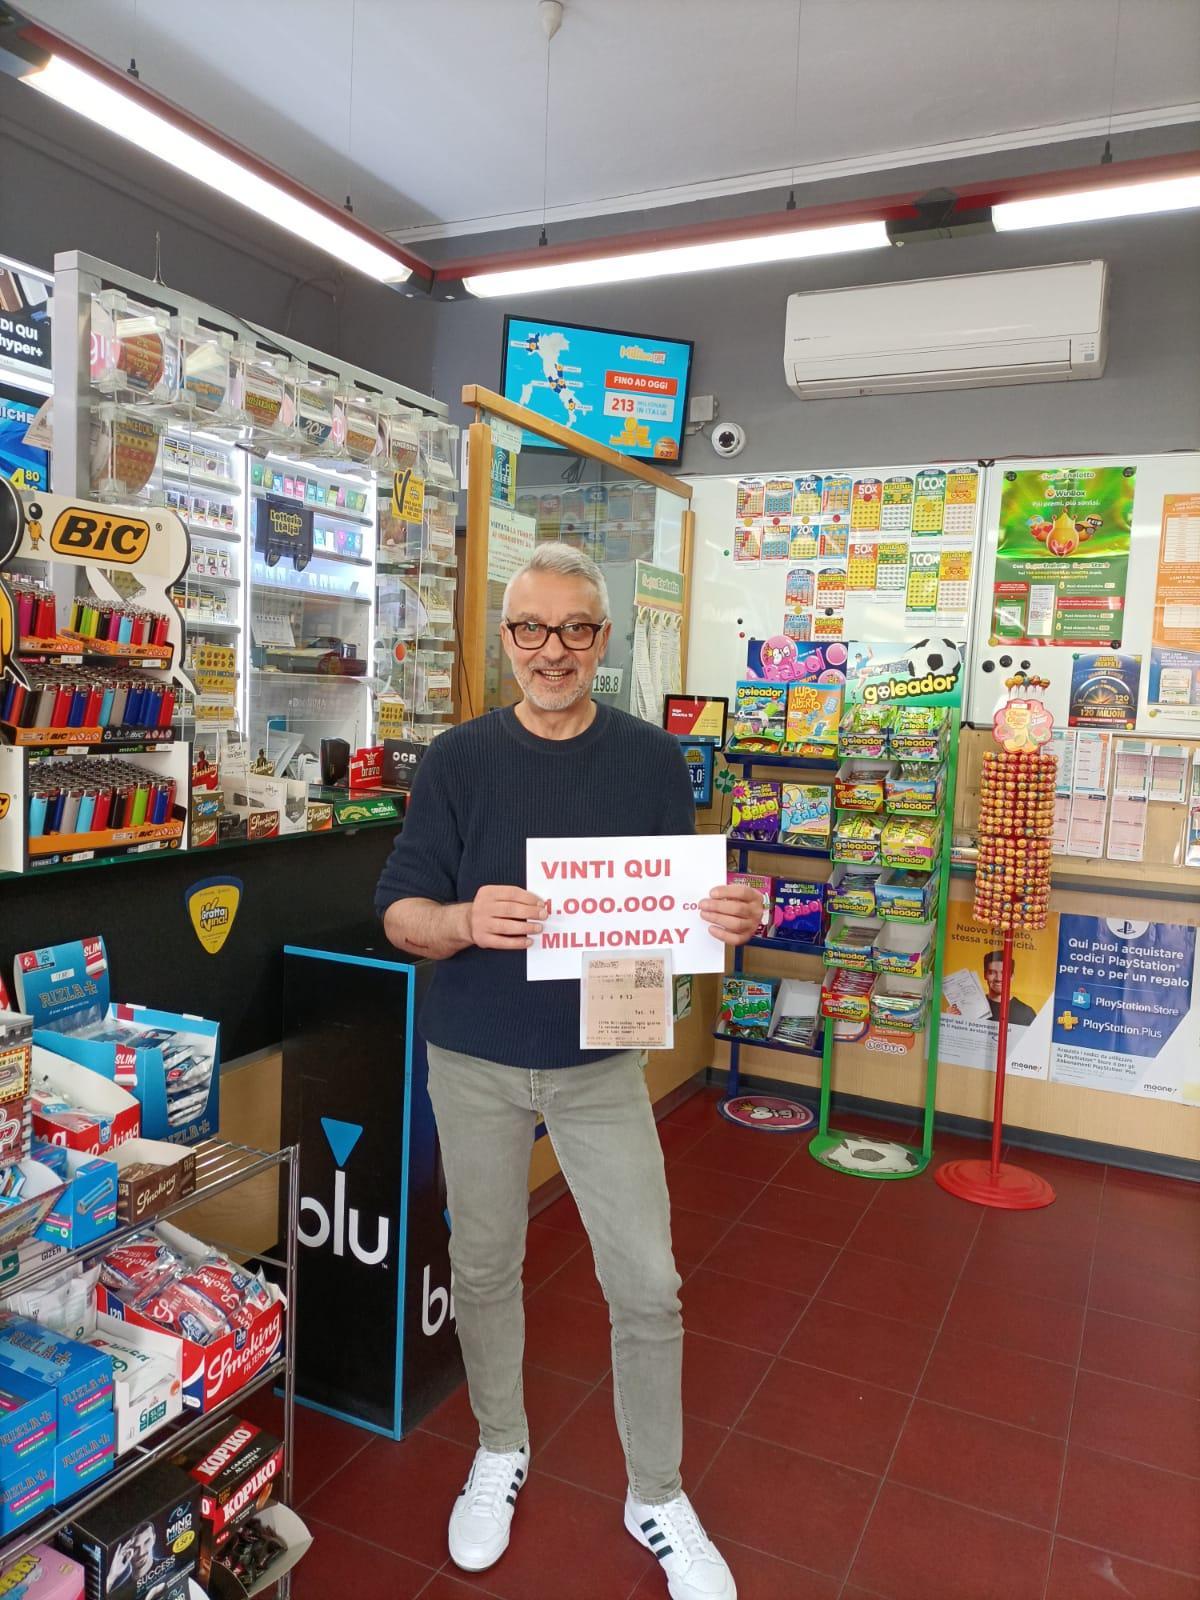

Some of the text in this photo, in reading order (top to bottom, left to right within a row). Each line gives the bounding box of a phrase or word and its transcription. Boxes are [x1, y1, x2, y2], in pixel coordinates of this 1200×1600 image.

[15, 323, 38, 341] QUI
[613, 375, 669, 390] FINO AD OGGI
[611, 398, 635, 413] 213
[645, 408, 668, 416] ITALIA
[799, 481, 817, 491] 20X
[858, 484, 878, 495] 50X
[918, 477, 945, 491] 100X
[269, 509, 303, 527] Lotteria
[274, 521, 300, 537] Italia
[854, 544, 874, 554] 50X
[911, 553, 940, 567] 100X
[737, 685, 784, 699] goleador
[794, 686, 818, 697] LUPO
[864, 673, 957, 705] goleador
[841, 735, 885, 746] goleador
[892, 737, 937, 748] goleador
[392, 751, 417, 764] OCB
[361, 765, 381, 777] bravo
[840, 797, 876, 806] goleador
[889, 800, 933, 811] goleador
[834, 840, 878, 851] goleador
[886, 854, 925, 865] goleador
[540, 858, 672, 880] VINTI QUI
[201, 908, 226, 920] Gratta
[833, 902, 869, 912] goleador
[879, 906, 922, 918] goleador
[541, 927, 691, 949] MILLIONDAY
[956, 923, 1034, 942] Nuovo forato,
[83, 940, 102, 957] SLIM
[951, 933, 1038, 951] stessa semicità.
[1068, 938, 1185, 960] Qui puoi acquistare
[1070, 952, 1105, 964] codici
[1059, 964, 1190, 988] per te o per un regalo
[1095, 996, 1180, 1016] PlayStation Store
[1082, 1018, 1163, 1039] PlayStation Plus
[114, 1054, 137, 1065] SLIM
[136, 1174, 177, 1215] Smoking
[206, 1313, 282, 1399] Smoking
[243, 1346, 267, 1375] FILTERS
[197, 1427, 253, 1477] KOPIKO
[230, 1446, 263, 1470] CARAMELLA
[222, 1458, 277, 1522] KOPIKO
[166, 1513, 193, 1538] MIND
[136, 1555, 176, 1587] SUCCESS
